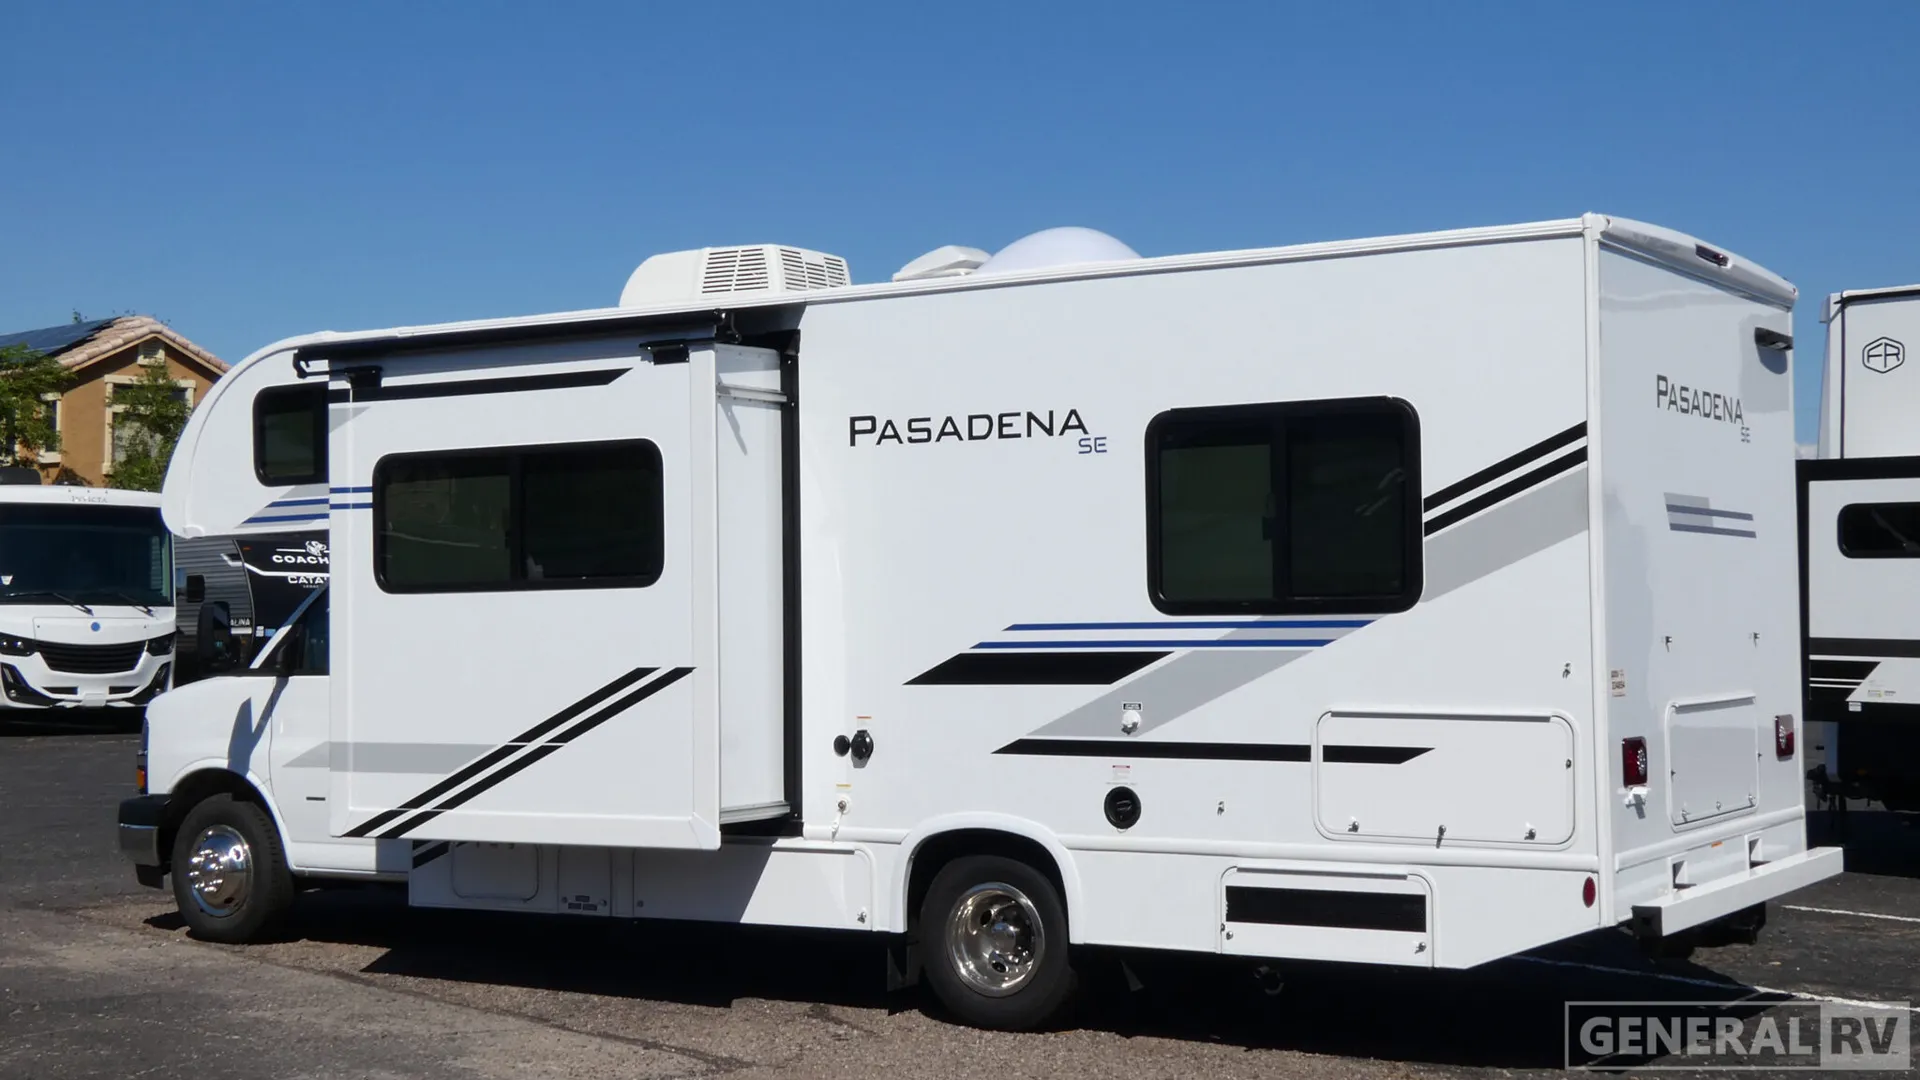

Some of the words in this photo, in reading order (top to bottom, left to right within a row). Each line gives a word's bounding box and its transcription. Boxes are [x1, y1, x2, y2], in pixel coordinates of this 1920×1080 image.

[1656, 374, 1744, 425] PASADENA
[849, 408, 1089, 447] PASADENA
[1078, 436, 1107, 454] SE
